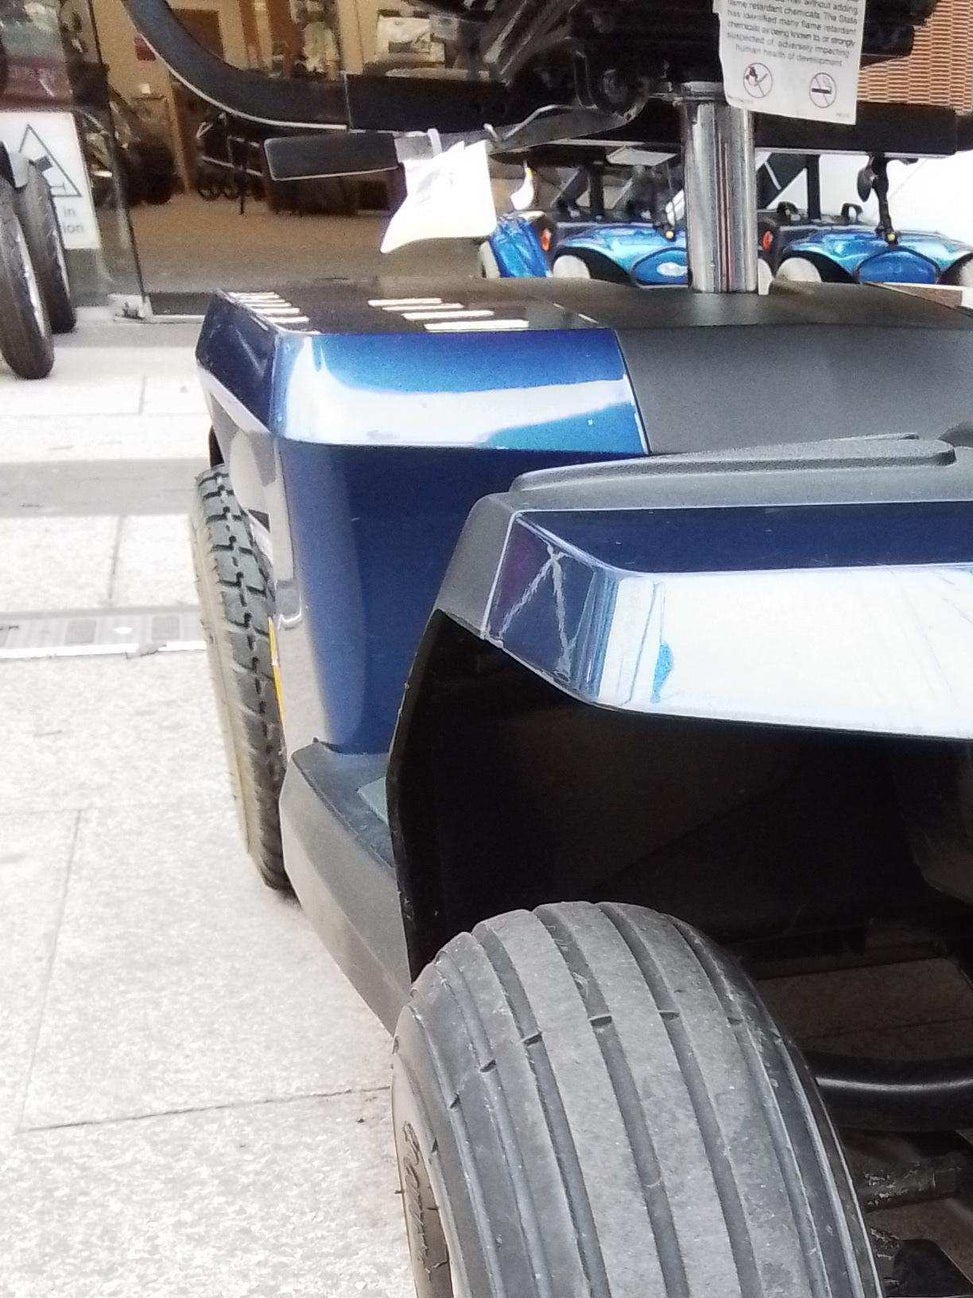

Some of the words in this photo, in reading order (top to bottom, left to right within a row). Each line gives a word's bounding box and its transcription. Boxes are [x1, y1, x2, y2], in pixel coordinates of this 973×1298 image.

[833, 4, 858, 15] adding
[779, 18, 799, 28] many
[801, 20, 822, 31] flame
[790, 31, 812, 40] known
